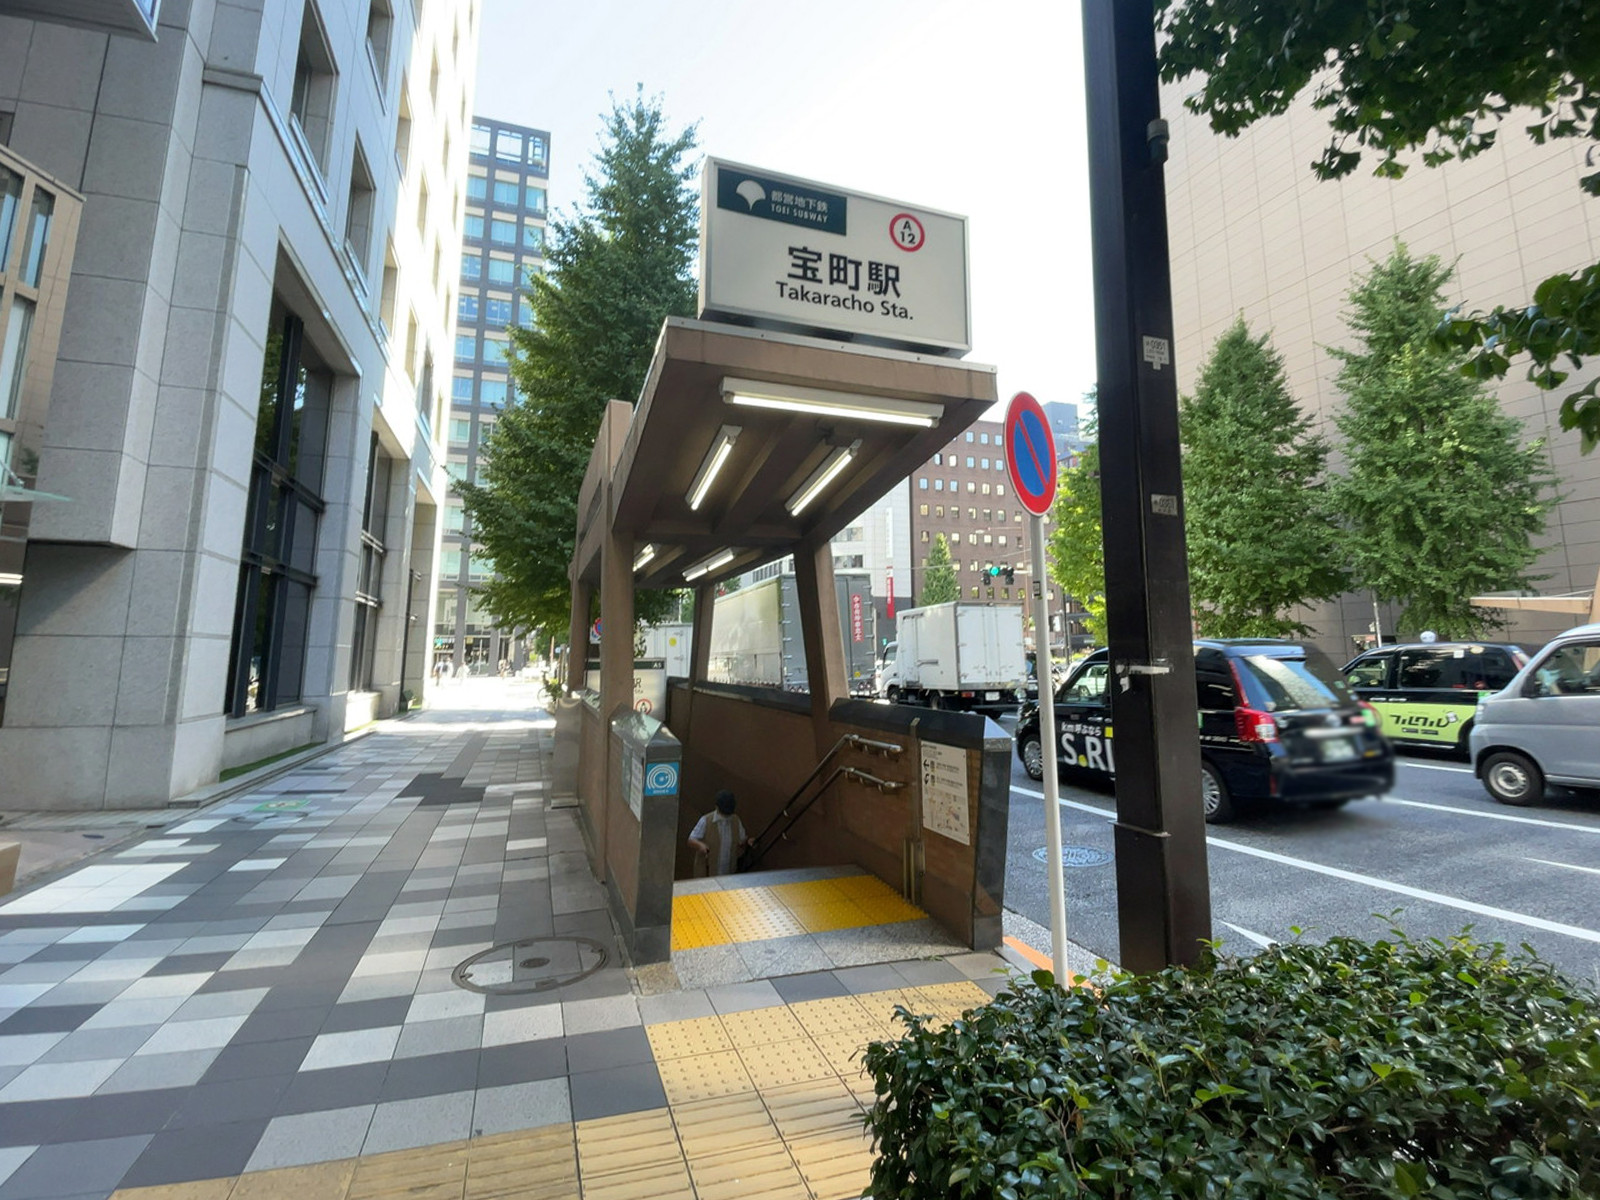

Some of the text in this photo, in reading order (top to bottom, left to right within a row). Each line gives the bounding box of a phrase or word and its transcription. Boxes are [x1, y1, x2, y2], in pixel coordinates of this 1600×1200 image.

[771, 203, 828, 224] TOEI SUBWAY
[903, 220, 912, 231] A
[900, 231, 916, 244] 12
[787, 246, 901, 299] 宝町駅
[775, 281, 914, 321] Takaracho Sta.
